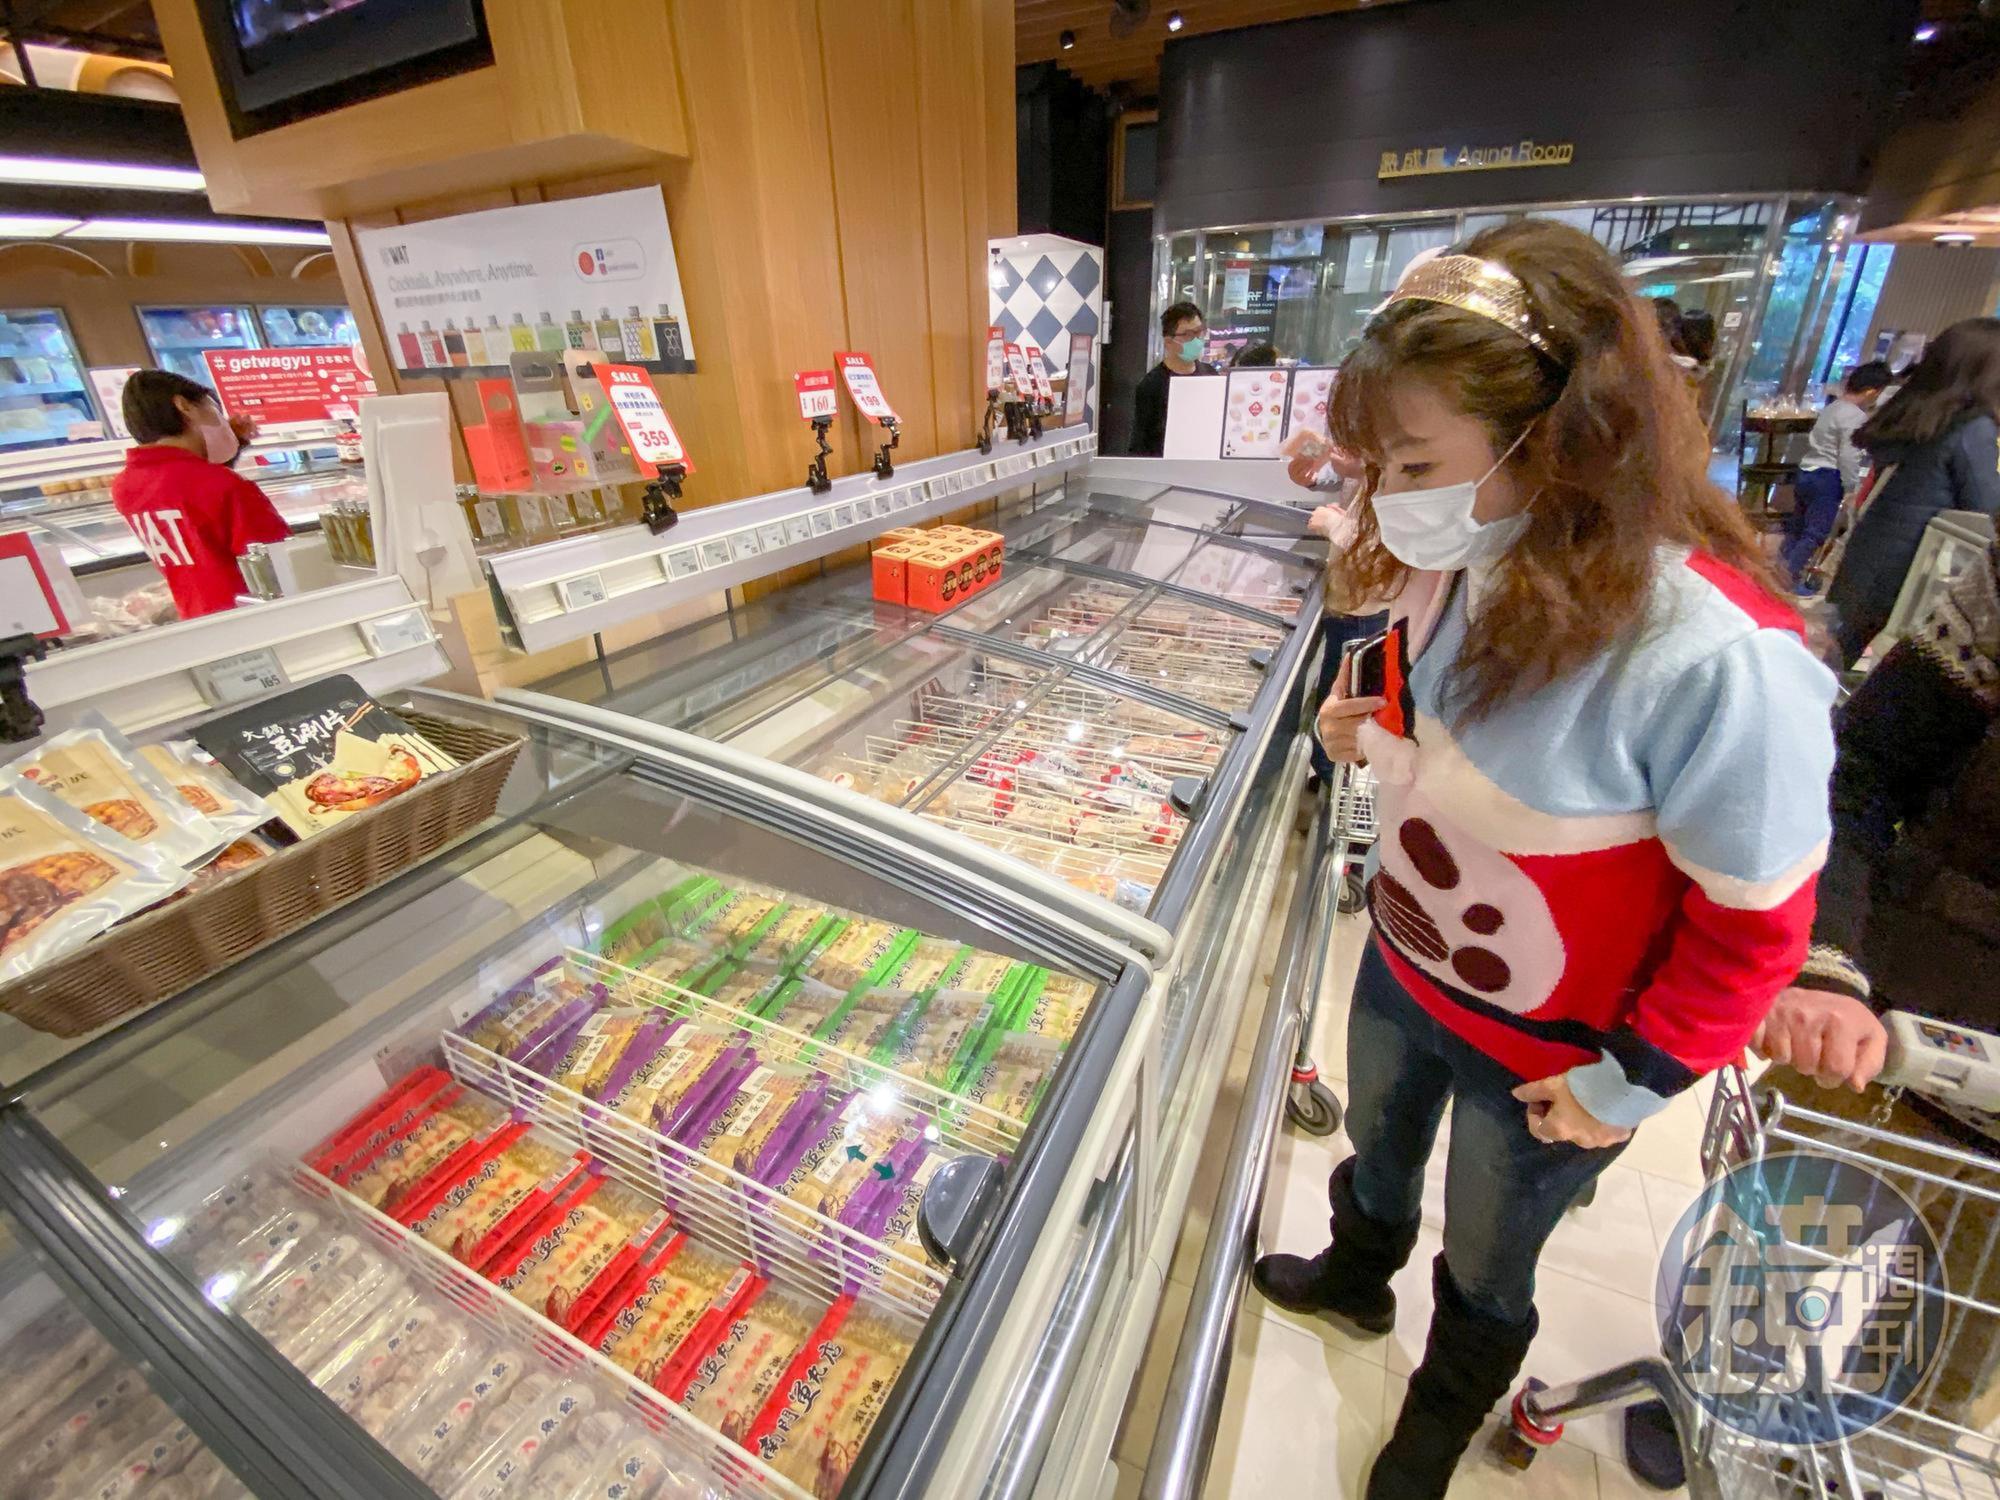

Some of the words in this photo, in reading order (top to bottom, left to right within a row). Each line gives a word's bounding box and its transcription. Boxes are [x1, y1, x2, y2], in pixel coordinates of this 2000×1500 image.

[1519, 141, 1574, 161] Room
[611, 370, 642, 384] SALE
[811, 395, 830, 411] 160
[861, 396, 881, 407] 199
[638, 430, 670, 448] 359
[260, 674, 281, 689] 165
